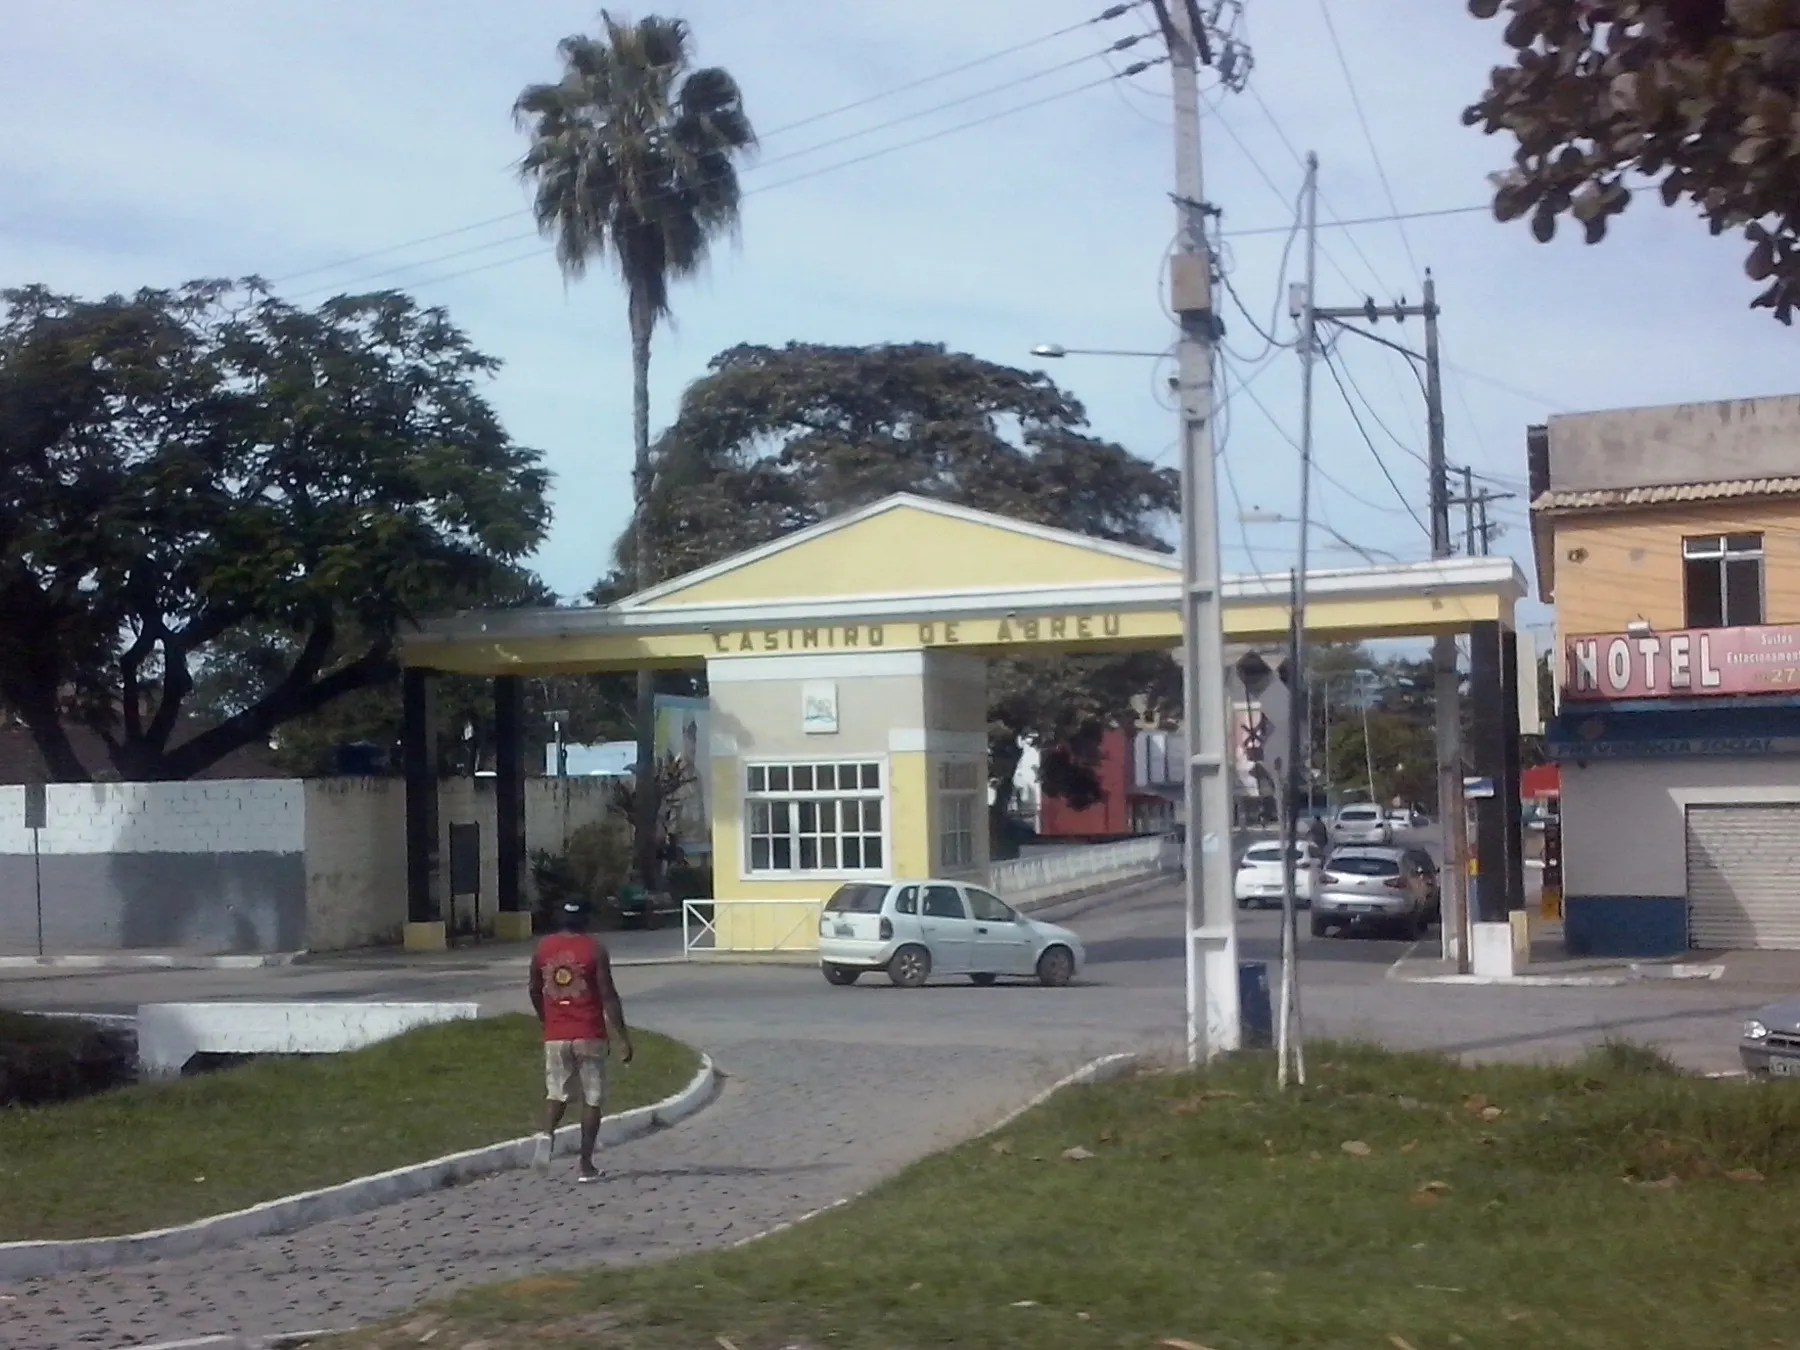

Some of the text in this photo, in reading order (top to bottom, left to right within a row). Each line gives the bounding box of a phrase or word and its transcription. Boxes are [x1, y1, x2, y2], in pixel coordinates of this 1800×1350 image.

[714, 614, 1120, 652] CASIMIRO DE ABREU
[1574, 633, 1721, 691] HOTEL
